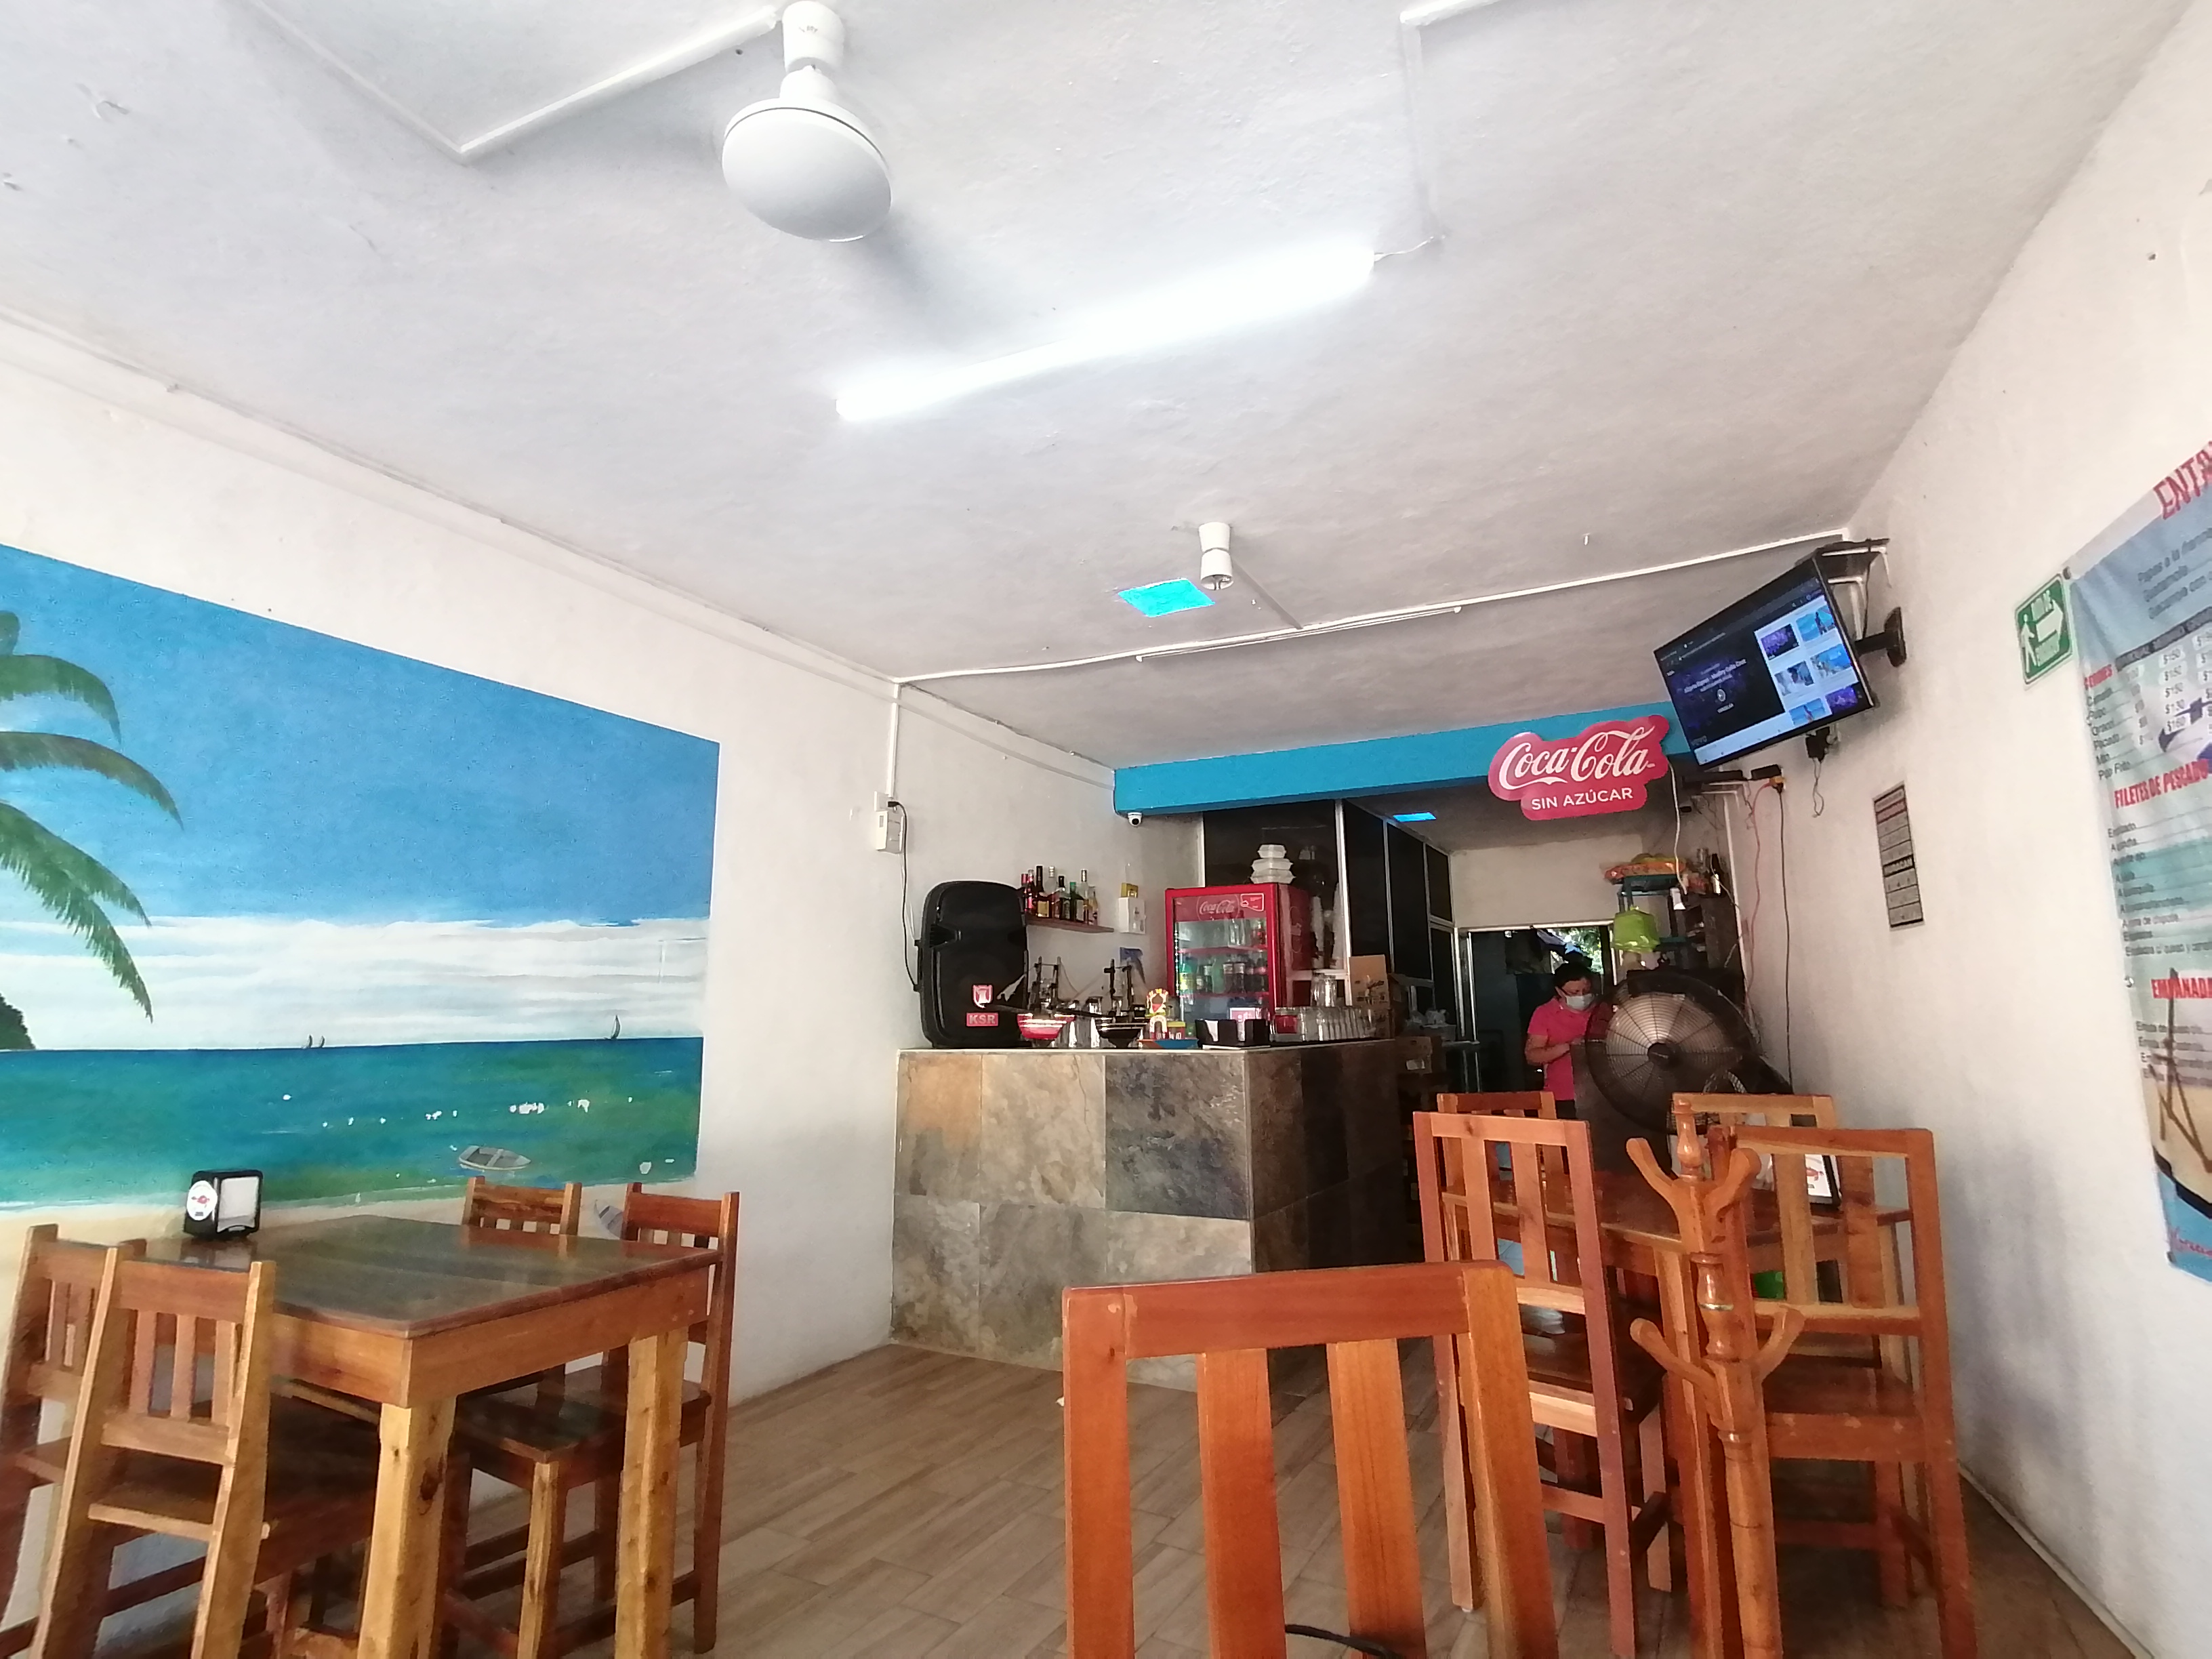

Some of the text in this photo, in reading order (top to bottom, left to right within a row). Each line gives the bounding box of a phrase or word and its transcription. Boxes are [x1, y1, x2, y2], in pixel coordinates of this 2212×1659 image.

[1499, 726, 1656, 790] Coca-Cola
[1532, 787, 1633, 811] SIN AZÚCAR
[2114, 781, 2150, 809] FILETES
[2148, 776, 2161, 798] DE
[969, 1015, 996, 1024] KSR
